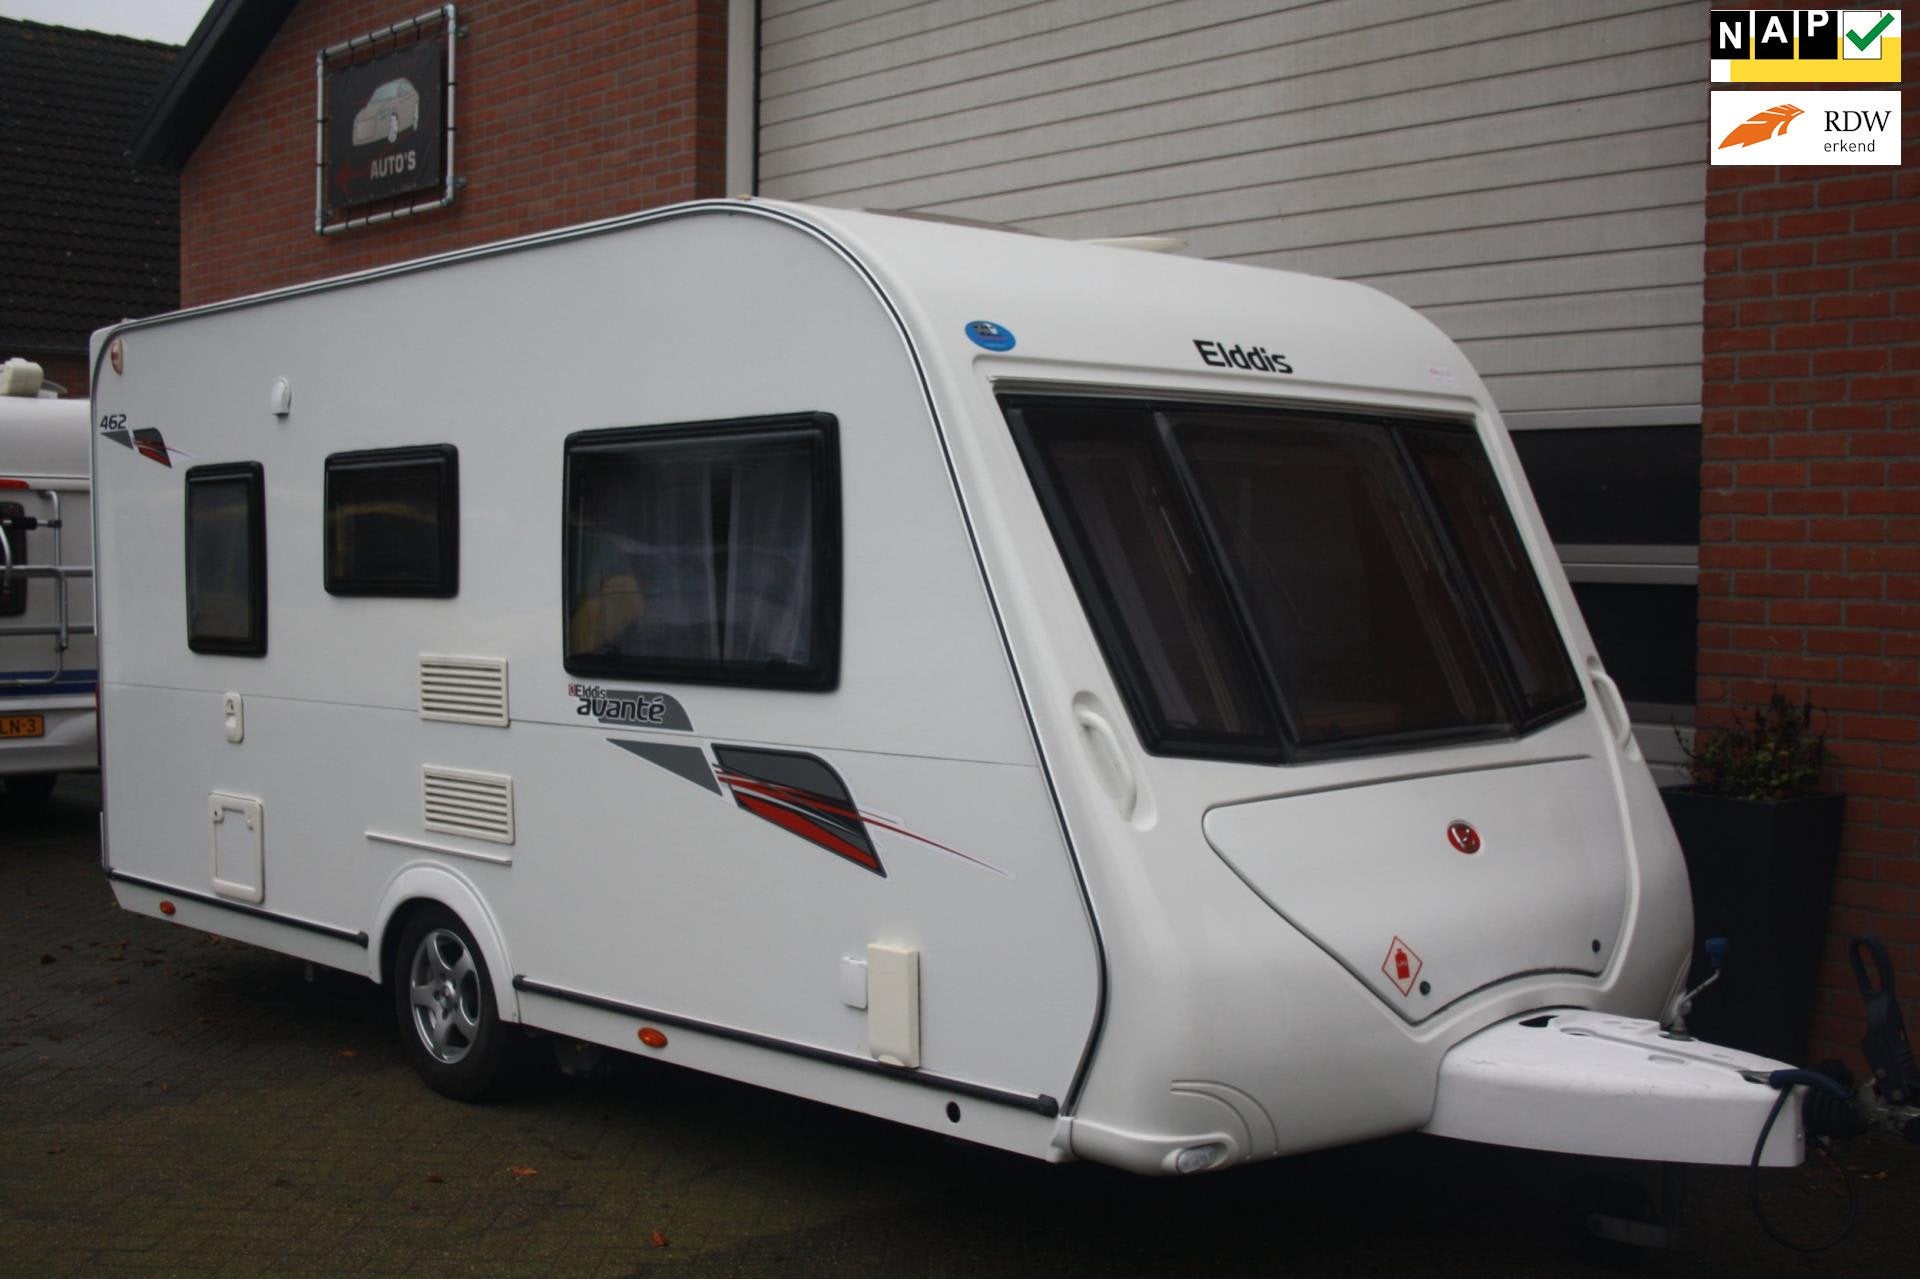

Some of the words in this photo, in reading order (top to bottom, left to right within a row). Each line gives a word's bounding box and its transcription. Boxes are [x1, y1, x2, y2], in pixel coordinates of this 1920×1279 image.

[370, 150, 417, 180] AUTO'S
[1193, 339, 1293, 374] Elddis
[100, 414, 127, 430] 462
[575, 684, 606, 699] Elddis
[577, 696, 665, 722] avanté
